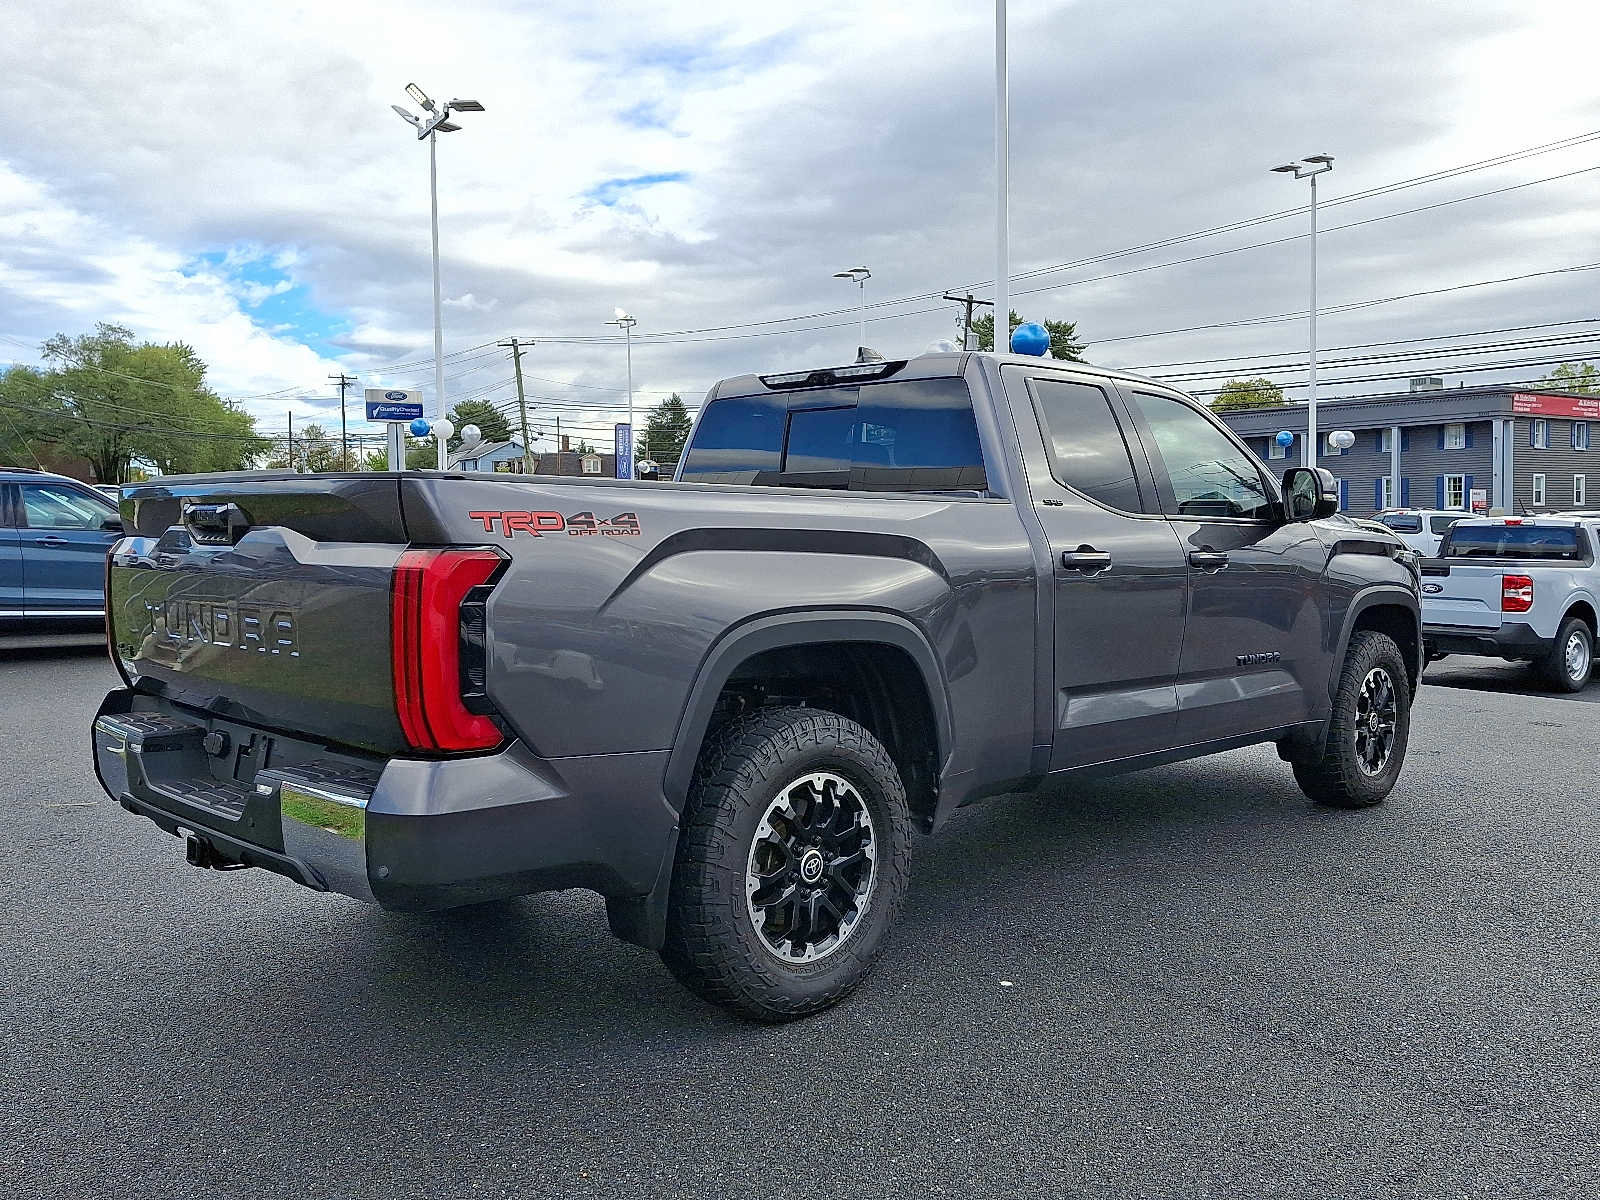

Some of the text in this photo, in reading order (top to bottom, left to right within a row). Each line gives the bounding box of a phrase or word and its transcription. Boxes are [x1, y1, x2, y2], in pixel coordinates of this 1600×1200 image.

[468, 511, 565, 538] TRD
[144, 600, 300, 657] TUNDRA
[1235, 650, 1281, 666] TUNDRA
